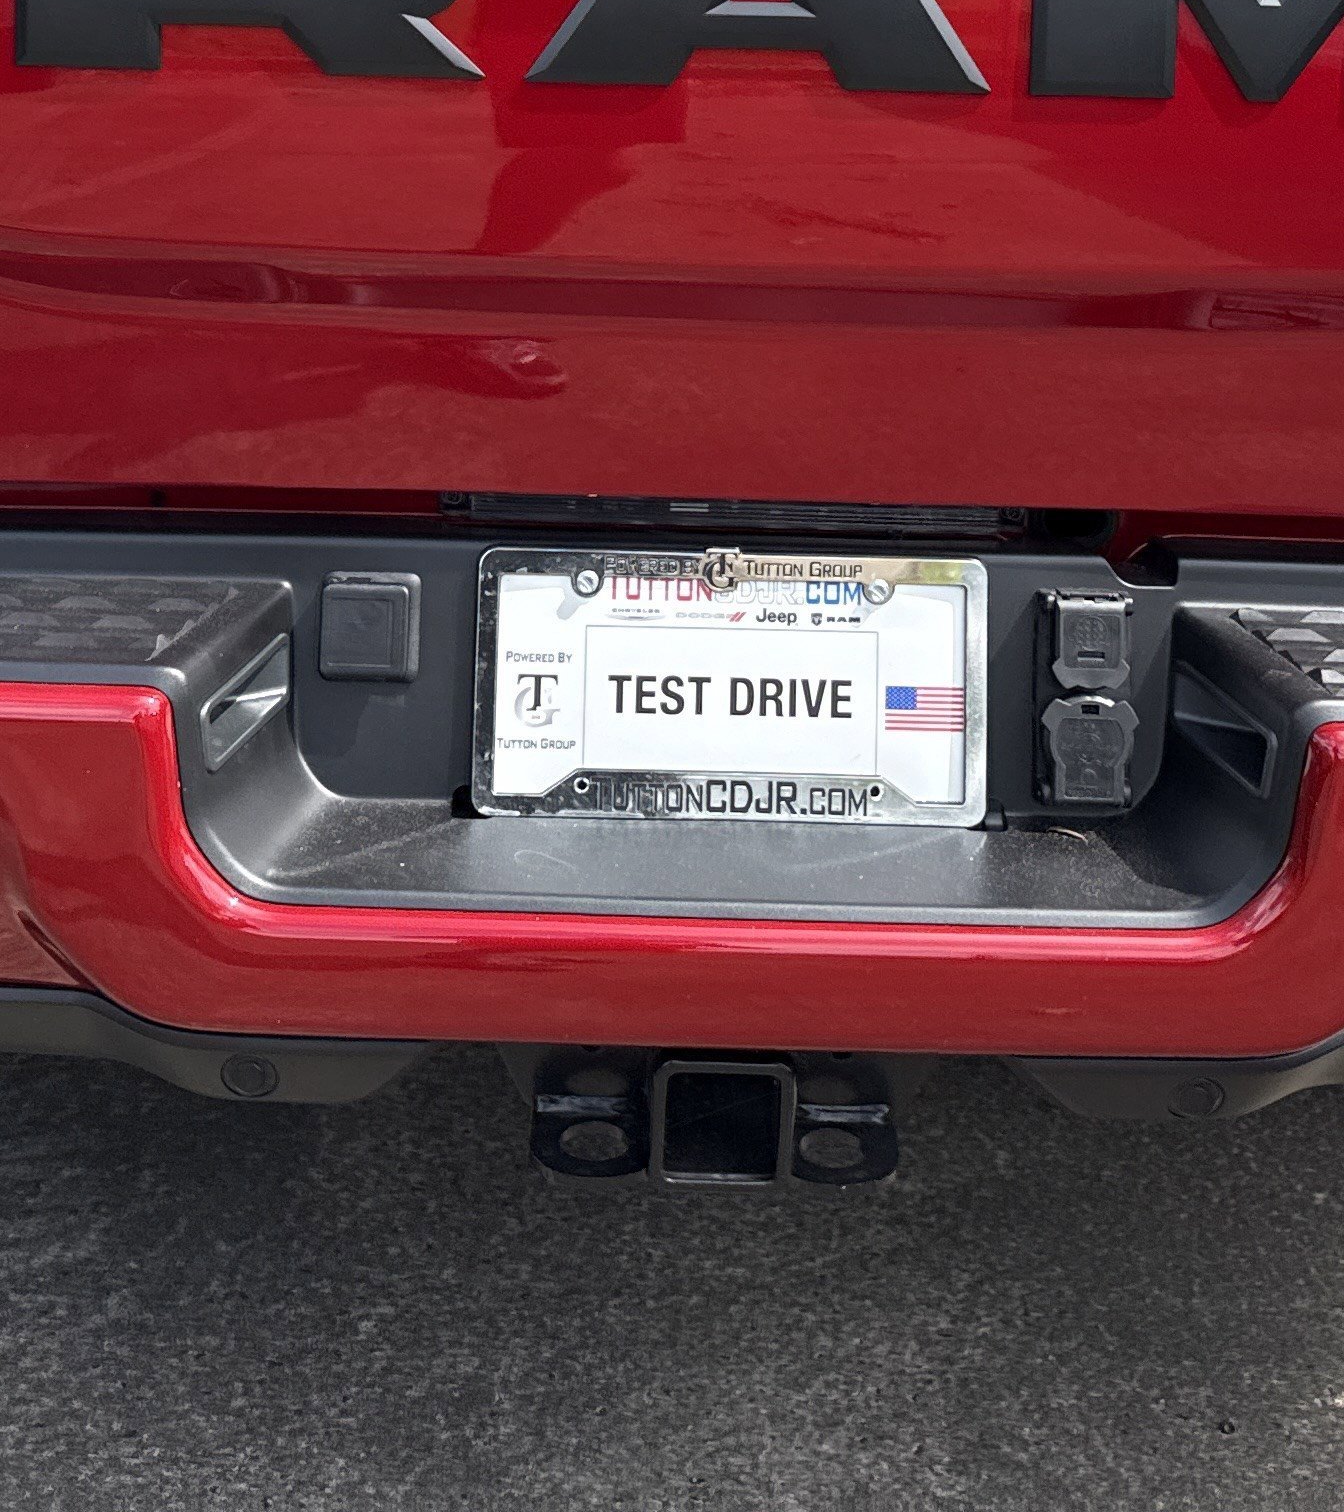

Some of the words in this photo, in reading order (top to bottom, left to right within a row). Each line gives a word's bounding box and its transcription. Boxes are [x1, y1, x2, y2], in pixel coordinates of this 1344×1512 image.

[743, 559, 803, 577] TUTTON
[809, 561, 862, 578] GROUP
[756, 608, 797, 626] Jeep
[506, 650, 555, 663] POWERED
[608, 675, 712, 715] TEST
[730, 678, 853, 719] DRIVE
[497, 737, 538, 749] TUTTON
[540, 738, 577, 750] GROUP
